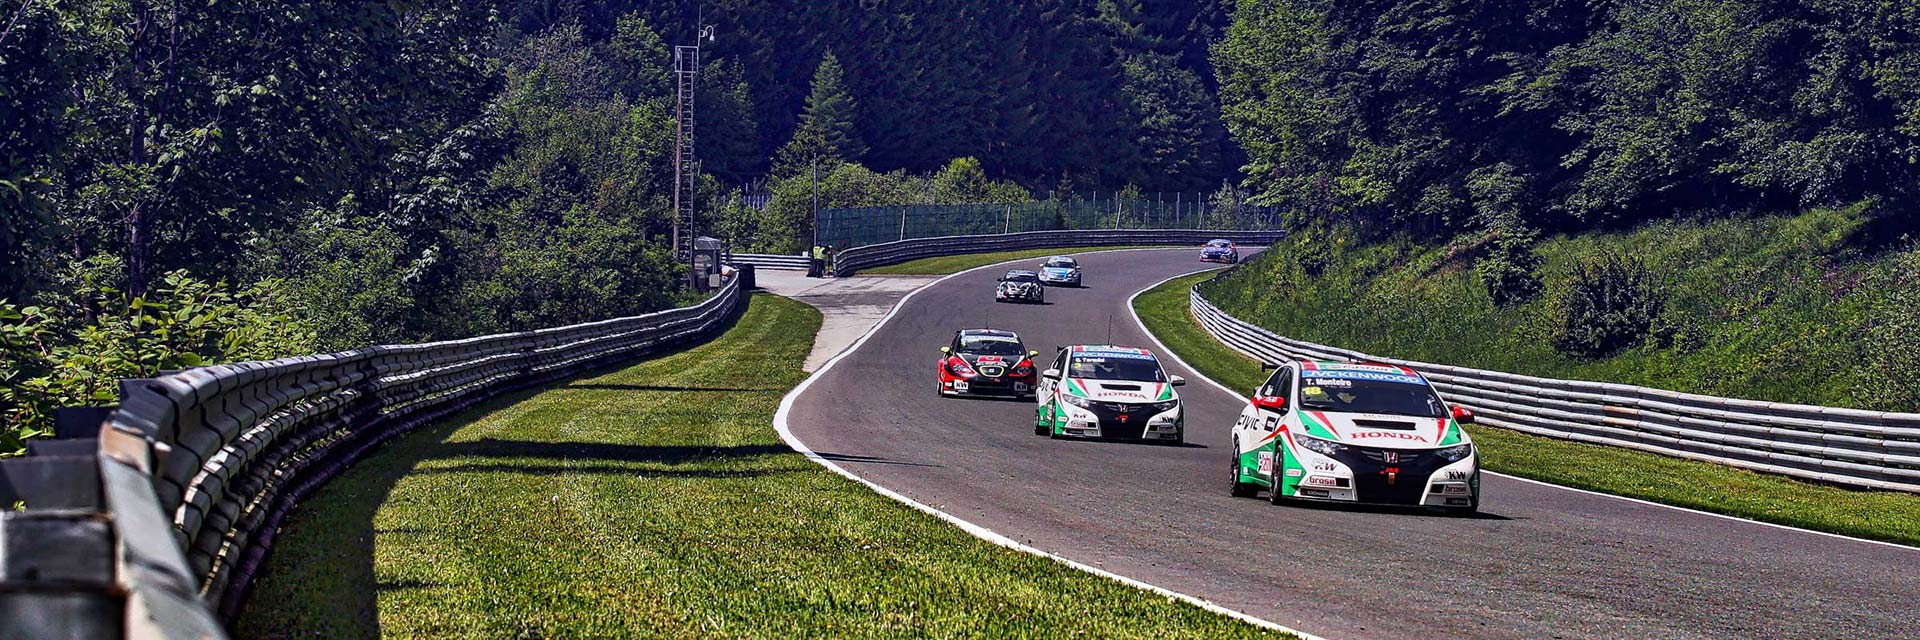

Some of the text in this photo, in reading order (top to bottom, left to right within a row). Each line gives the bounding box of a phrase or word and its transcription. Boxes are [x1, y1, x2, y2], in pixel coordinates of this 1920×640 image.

[1316, 379, 1352, 387] Monteiro
[1303, 386, 1321, 395] 18
[1098, 392, 1148, 400] HONDA
[1237, 414, 1260, 430] CIVIC
[1351, 432, 1428, 443] HONDA
[1449, 471, 1466, 480] KW
[1309, 476, 1335, 485] brose
